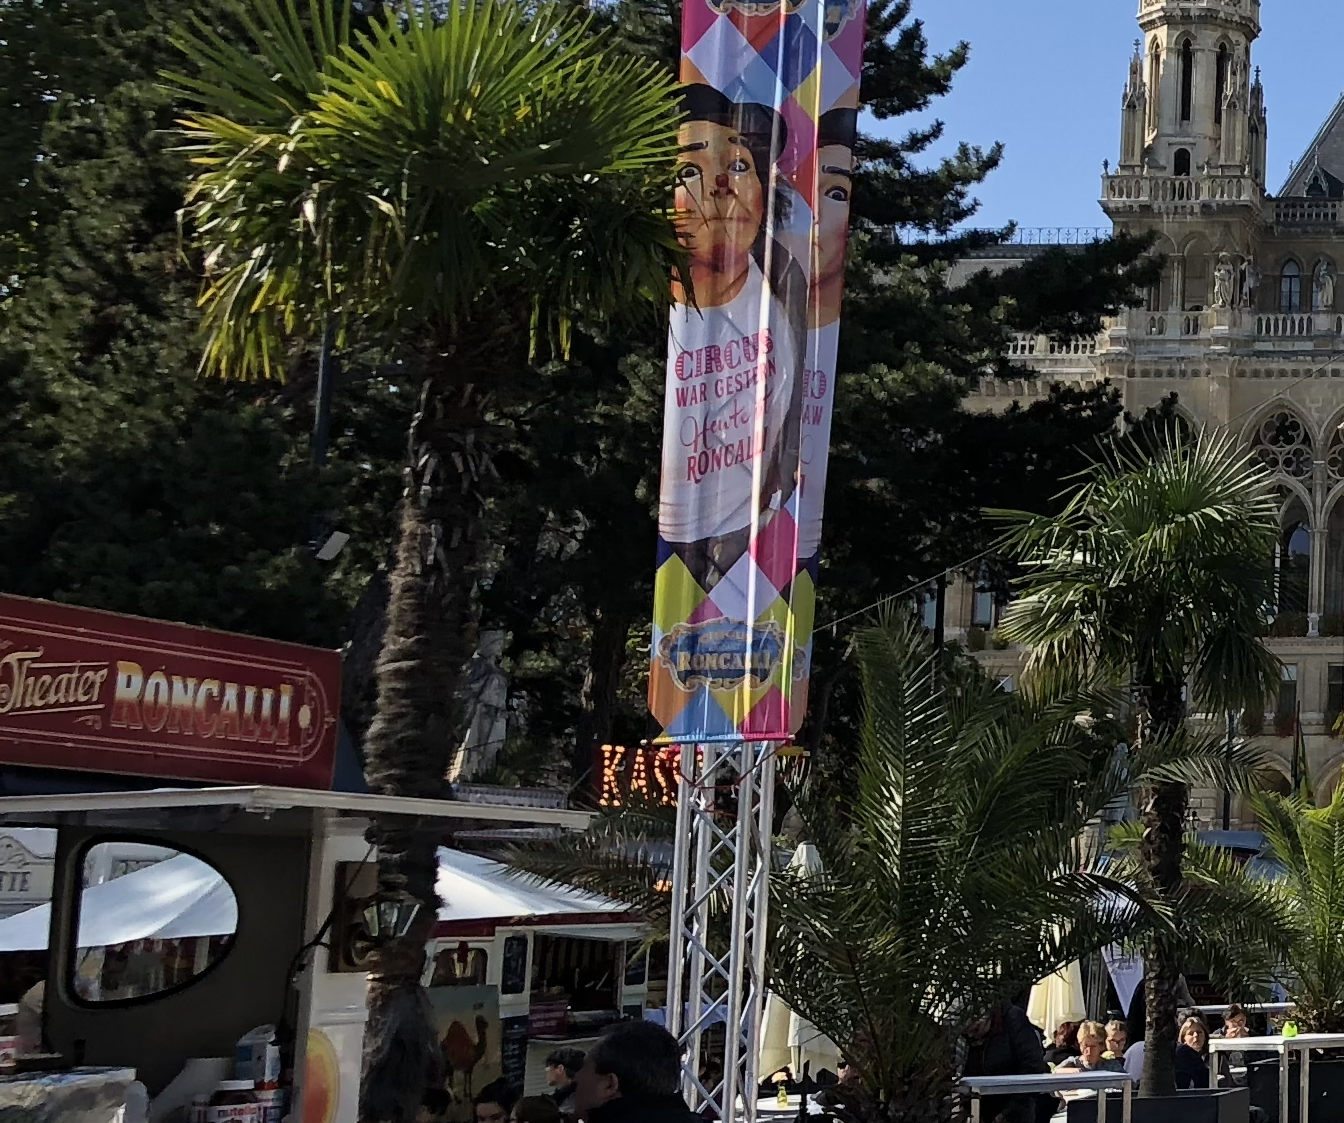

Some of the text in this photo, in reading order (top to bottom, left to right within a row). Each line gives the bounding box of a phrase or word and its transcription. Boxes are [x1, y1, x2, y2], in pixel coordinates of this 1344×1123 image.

[675, 328, 774, 381] CIRCUS
[675, 383, 707, 408] WAR
[687, 426, 770, 485] RONCALLI
[677, 651, 772, 672] RONCALLI
[0, 645, 294, 746] Theater RONCALLI
